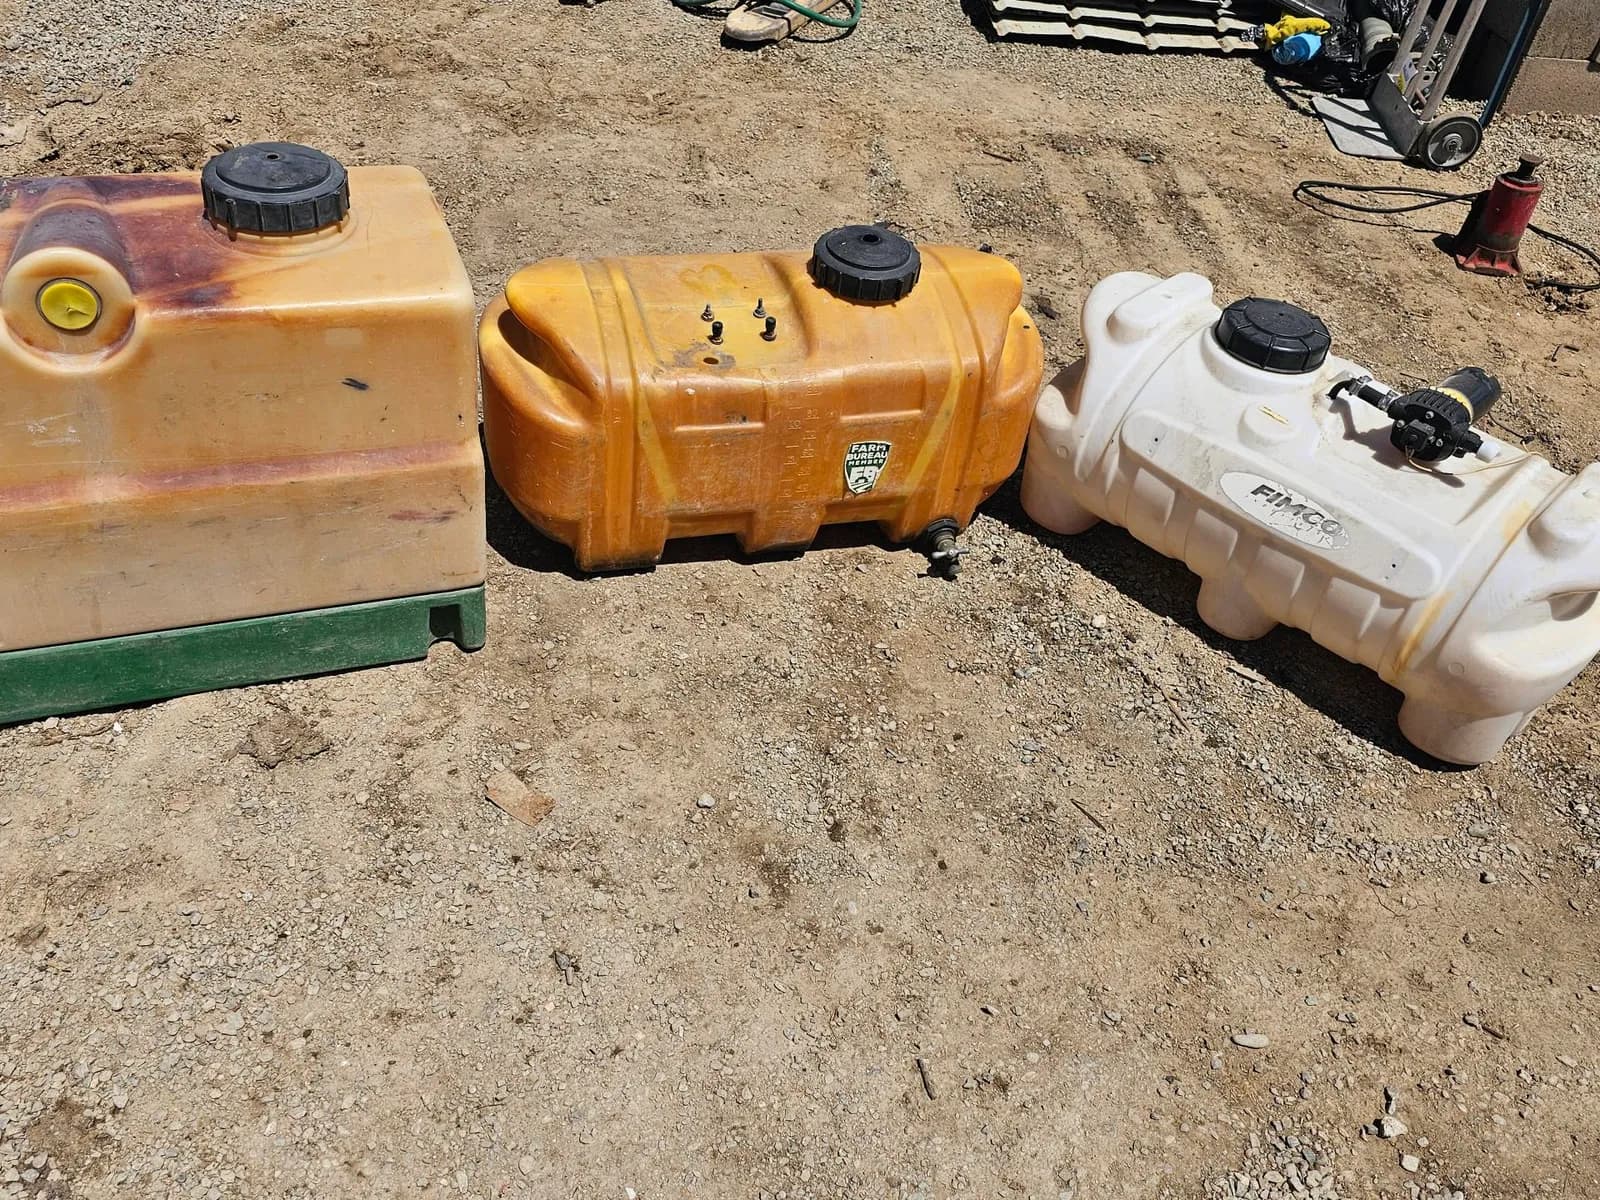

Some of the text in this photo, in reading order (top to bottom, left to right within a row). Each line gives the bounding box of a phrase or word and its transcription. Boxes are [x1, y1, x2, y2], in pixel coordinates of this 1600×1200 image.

[852, 444, 886, 453] FARM
[847, 451, 888, 461] BUREAU
[848, 458, 884, 466] MEMBER
[1250, 484, 1343, 537] FIMCO
